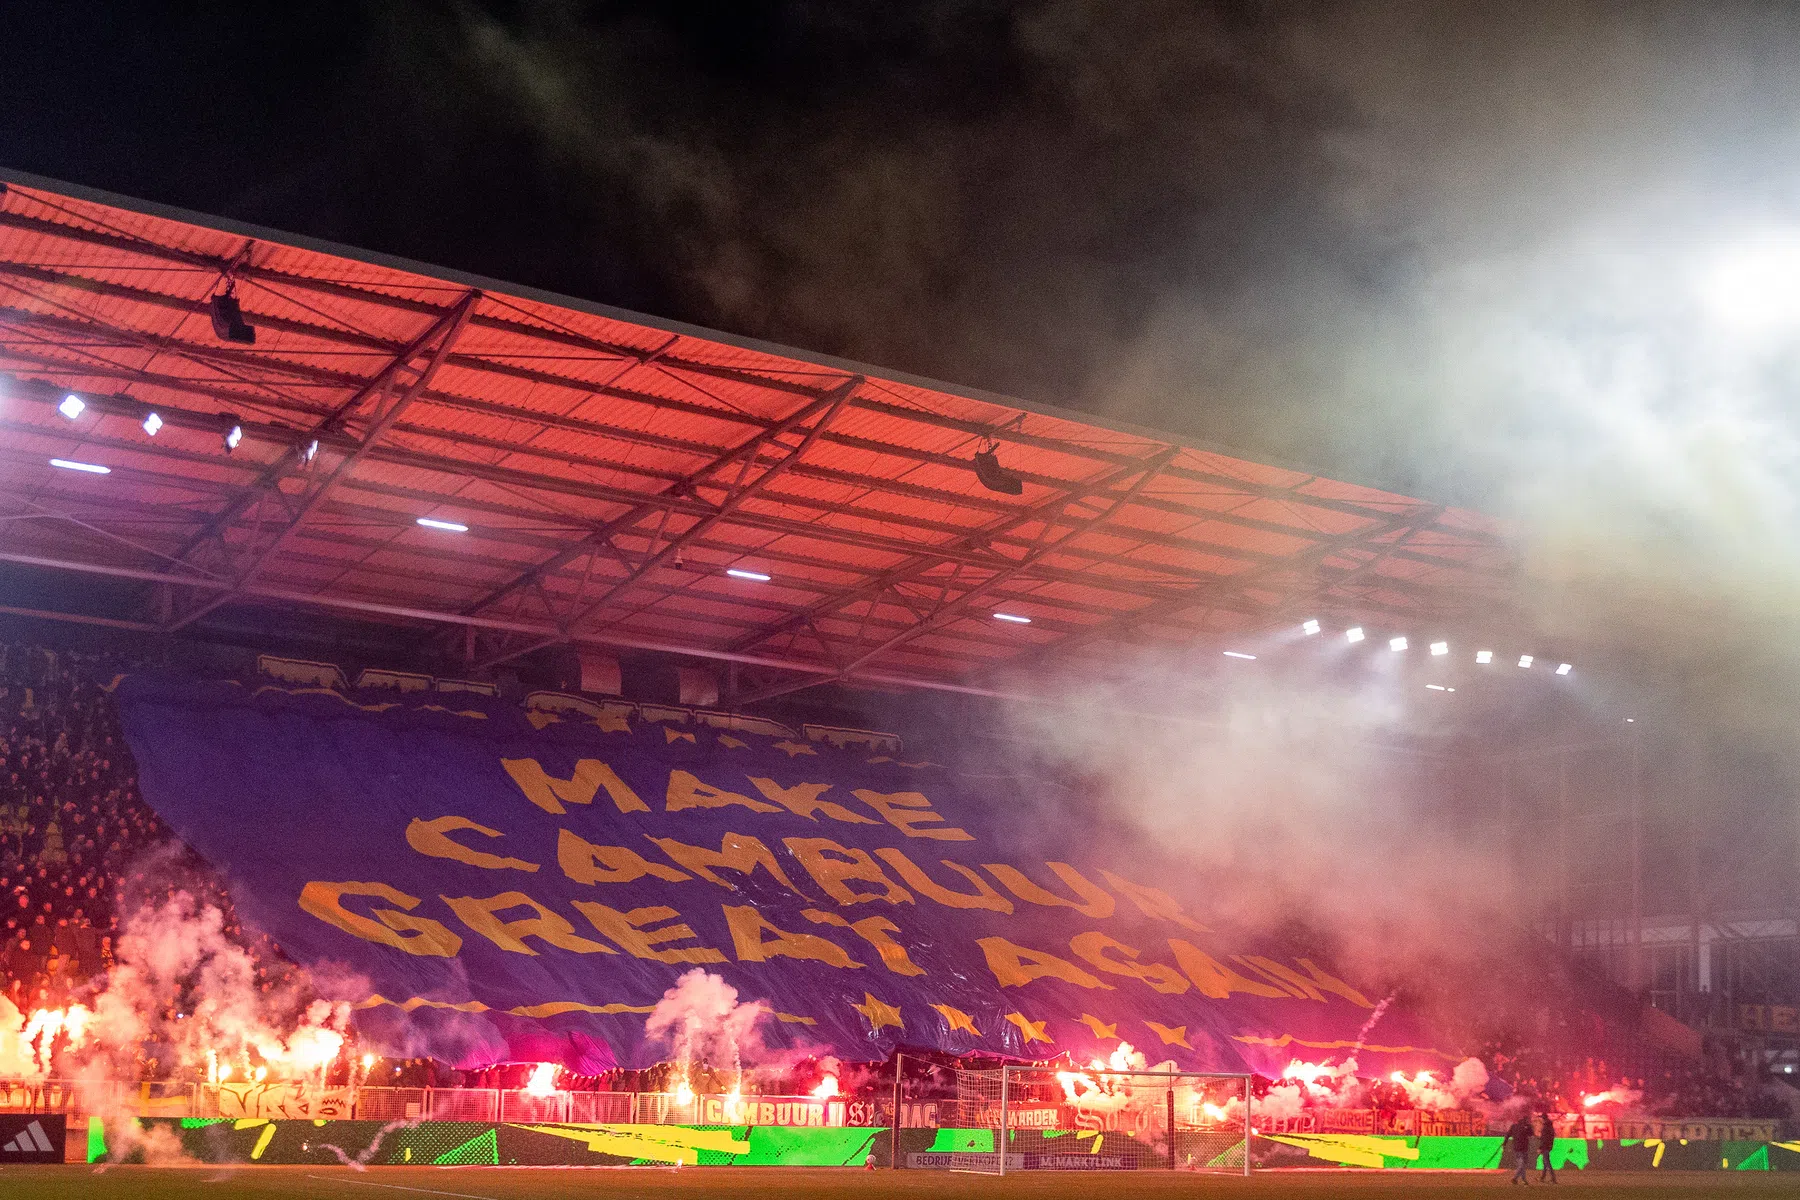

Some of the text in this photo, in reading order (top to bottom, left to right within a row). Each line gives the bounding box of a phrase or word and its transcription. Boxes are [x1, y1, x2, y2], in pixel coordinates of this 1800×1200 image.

[500, 757, 976, 841] MAKE
[405, 815, 1215, 933] CAMBUUR
[299, 881, 1376, 1009] GREAT AGAIN
[916, 1155, 953, 1166] BEDRIJF
[1056, 1156, 1122, 1167] MARKTLINK
